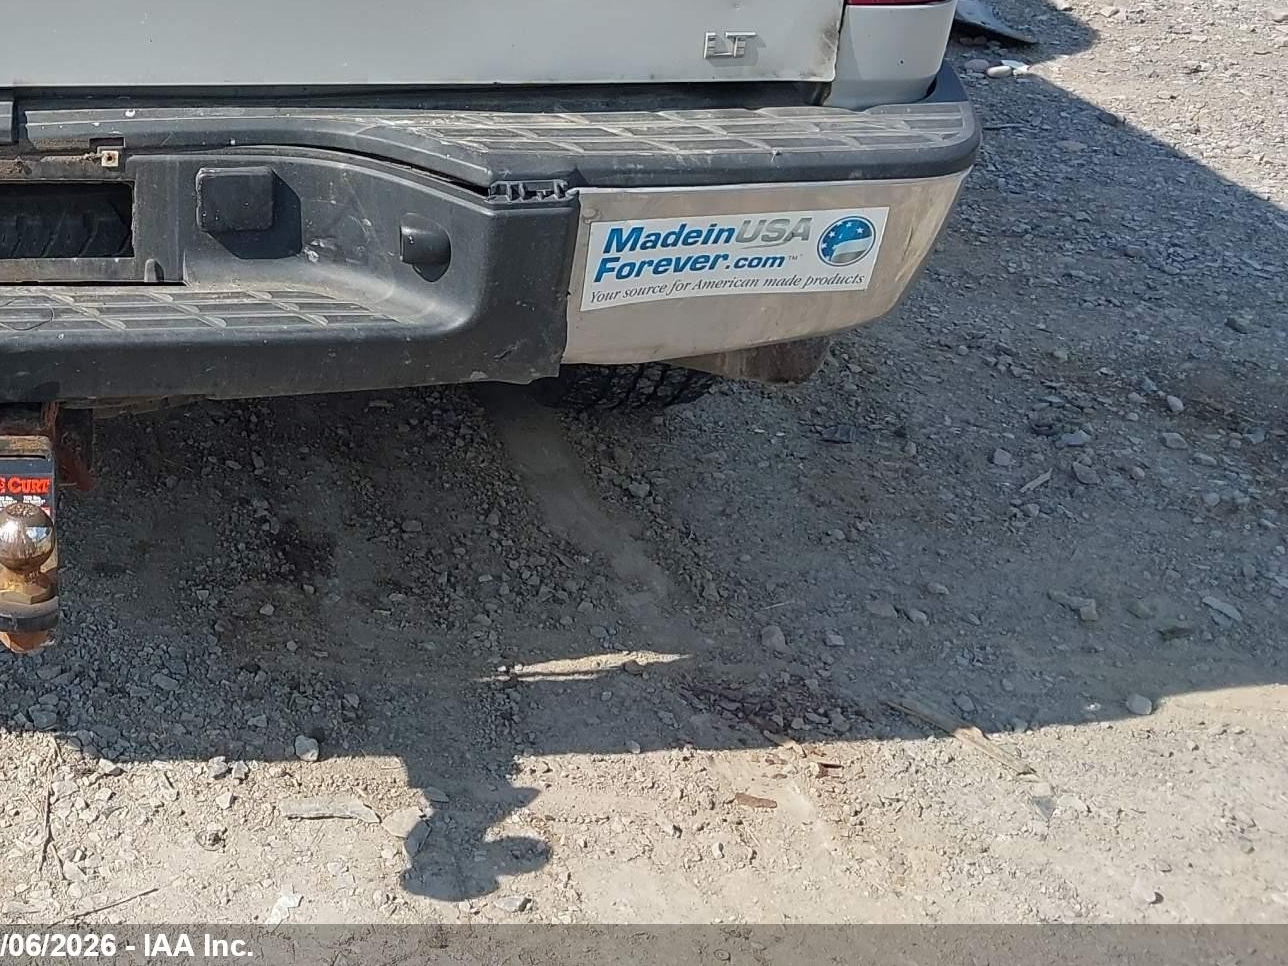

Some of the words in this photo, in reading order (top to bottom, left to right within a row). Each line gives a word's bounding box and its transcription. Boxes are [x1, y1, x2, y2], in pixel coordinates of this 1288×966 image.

[703, 31, 756, 58] LT
[593, 253, 786, 283] Forever.com
[591, 290, 621, 303] Your
[623, 282, 668, 297] source
[667, 278, 692, 295] for
[692, 275, 760, 290] American
[763, 274, 802, 287] made
[801, 273, 865, 289] products
